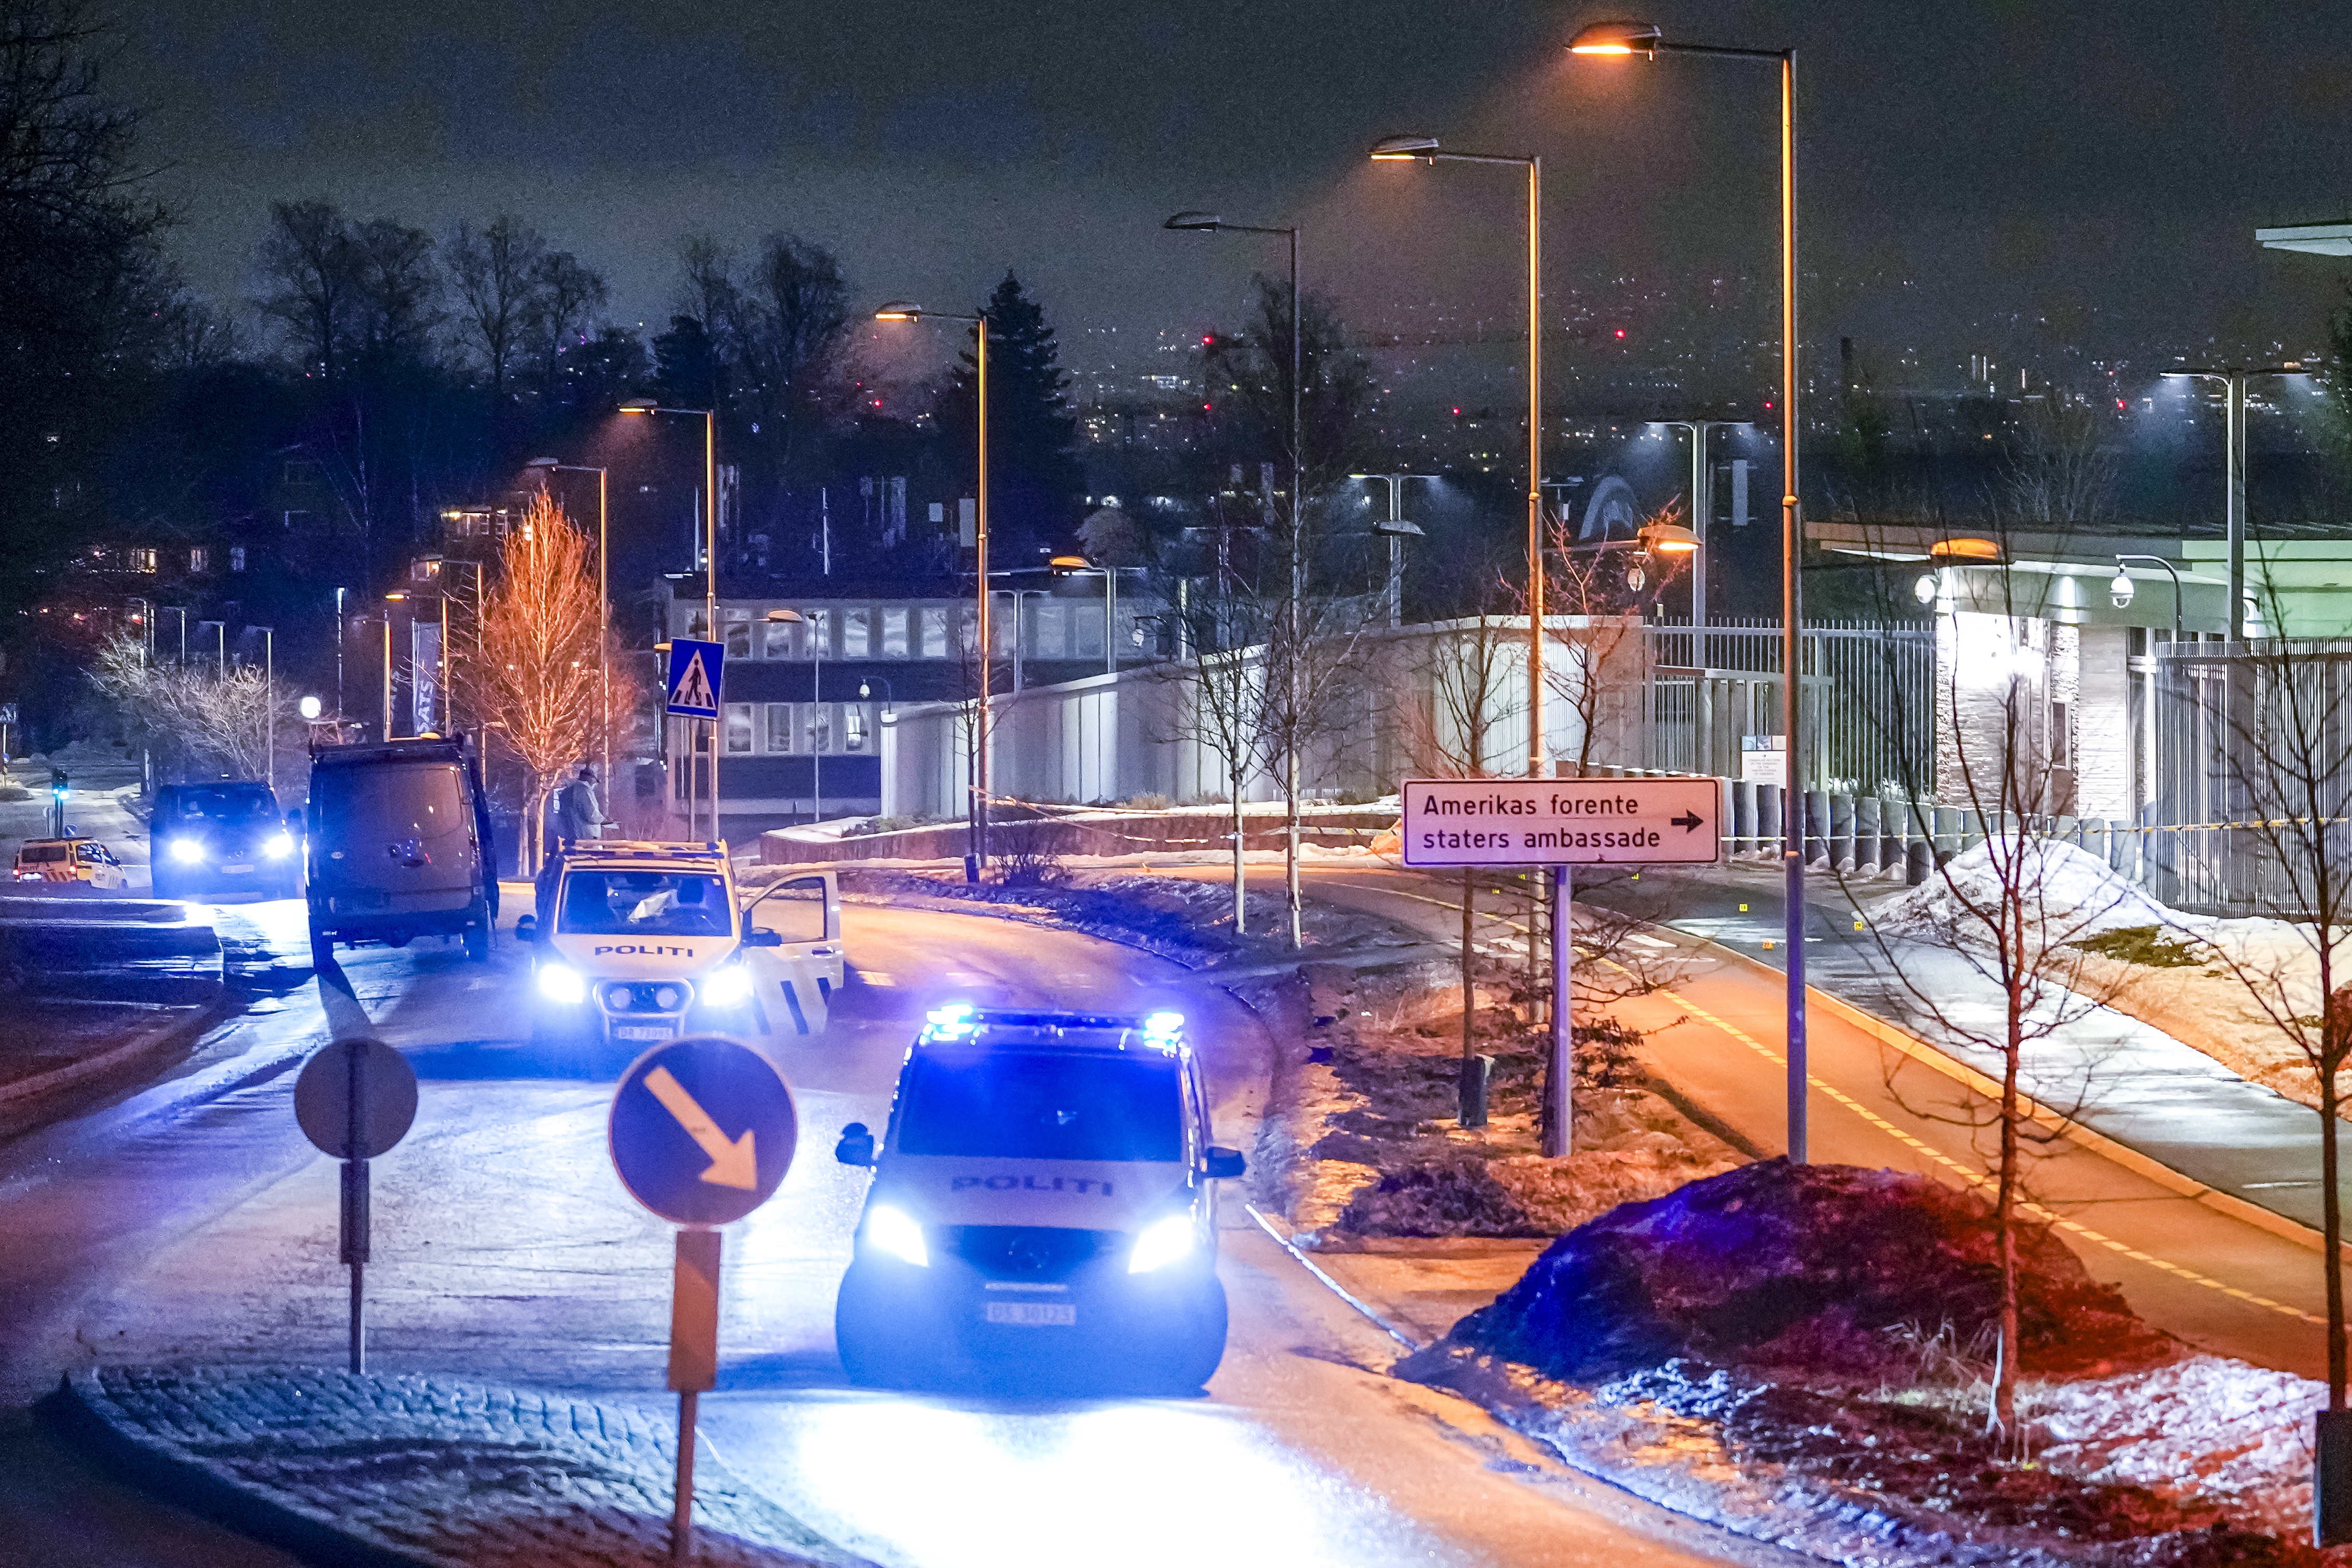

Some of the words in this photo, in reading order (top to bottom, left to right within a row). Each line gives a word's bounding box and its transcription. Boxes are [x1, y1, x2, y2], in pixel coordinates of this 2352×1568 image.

[417, 680, 433, 732] SATS
[1423, 794, 1537, 816] Amerikas
[1550, 794, 1639, 815] forente
[1423, 829, 1509, 849] staters
[1524, 827, 1660, 848] ambassade
[595, 945, 693, 957] POLITI
[951, 1175, 1113, 1196] POLITI
